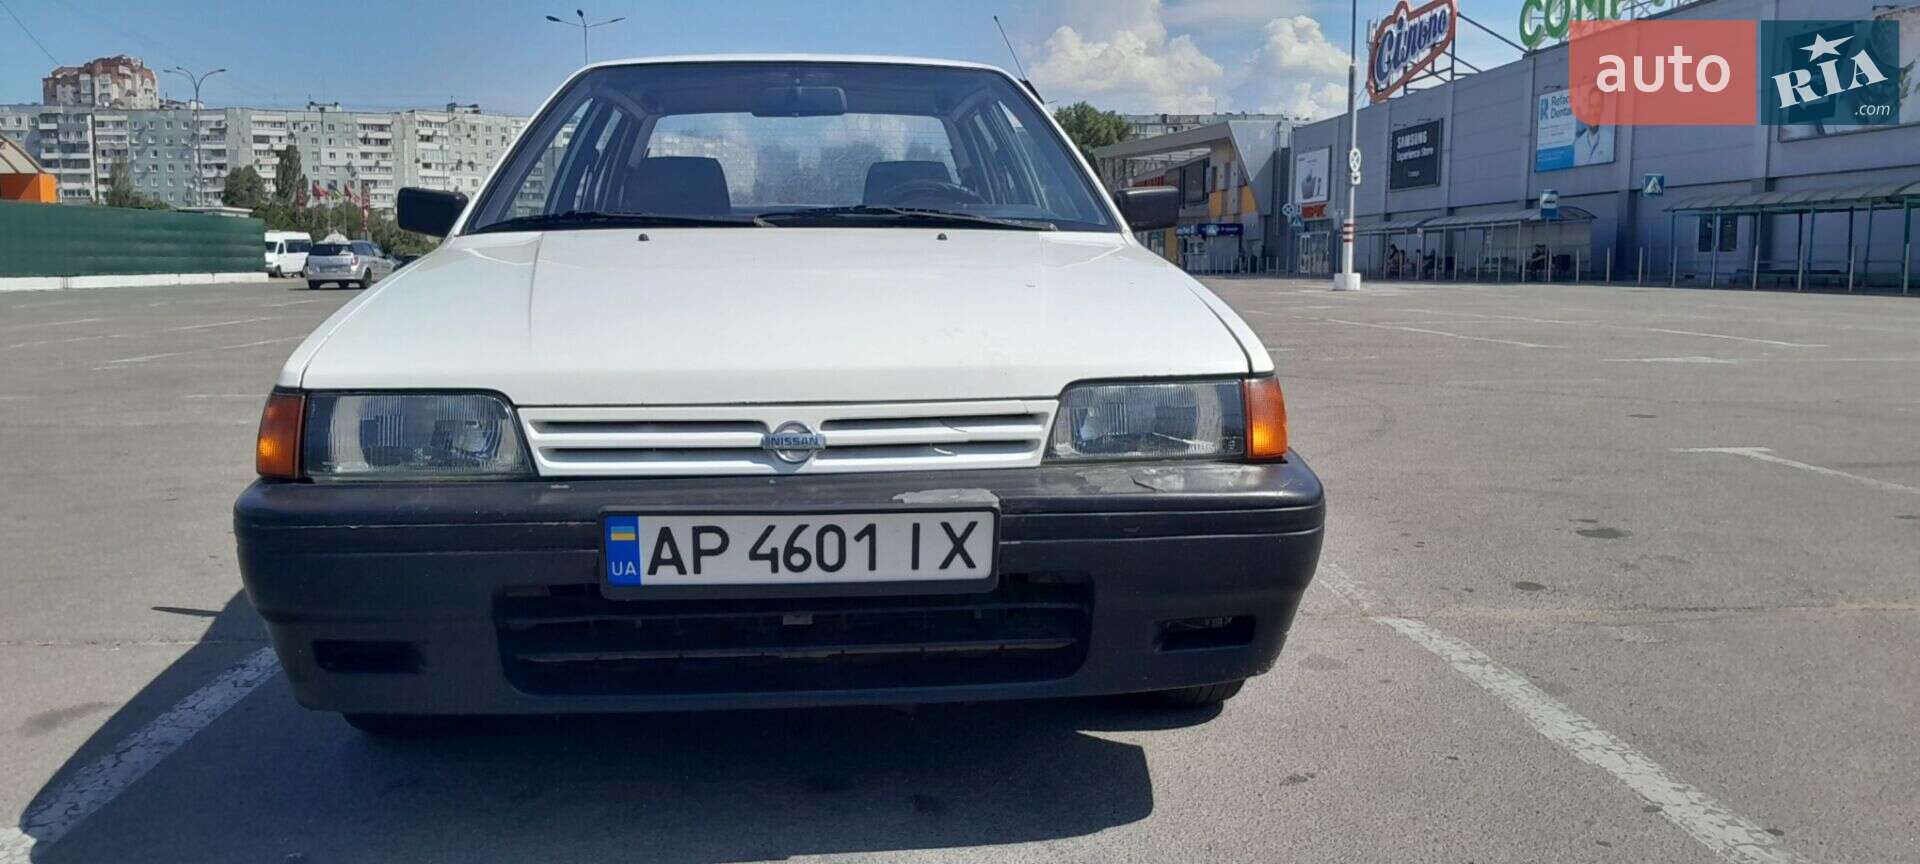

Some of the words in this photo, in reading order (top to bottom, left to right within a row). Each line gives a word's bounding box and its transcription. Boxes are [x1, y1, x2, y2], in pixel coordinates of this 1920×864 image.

[1376, 9, 1447, 81] Сільпо
[1397, 130, 1428, 149] SAMSUNG
[1421, 147, 1434, 157] Store
[770, 436, 819, 446] NISSAN
[647, 525, 730, 576] AP
[748, 522, 877, 574] 4601
[611, 561, 637, 577] UA
